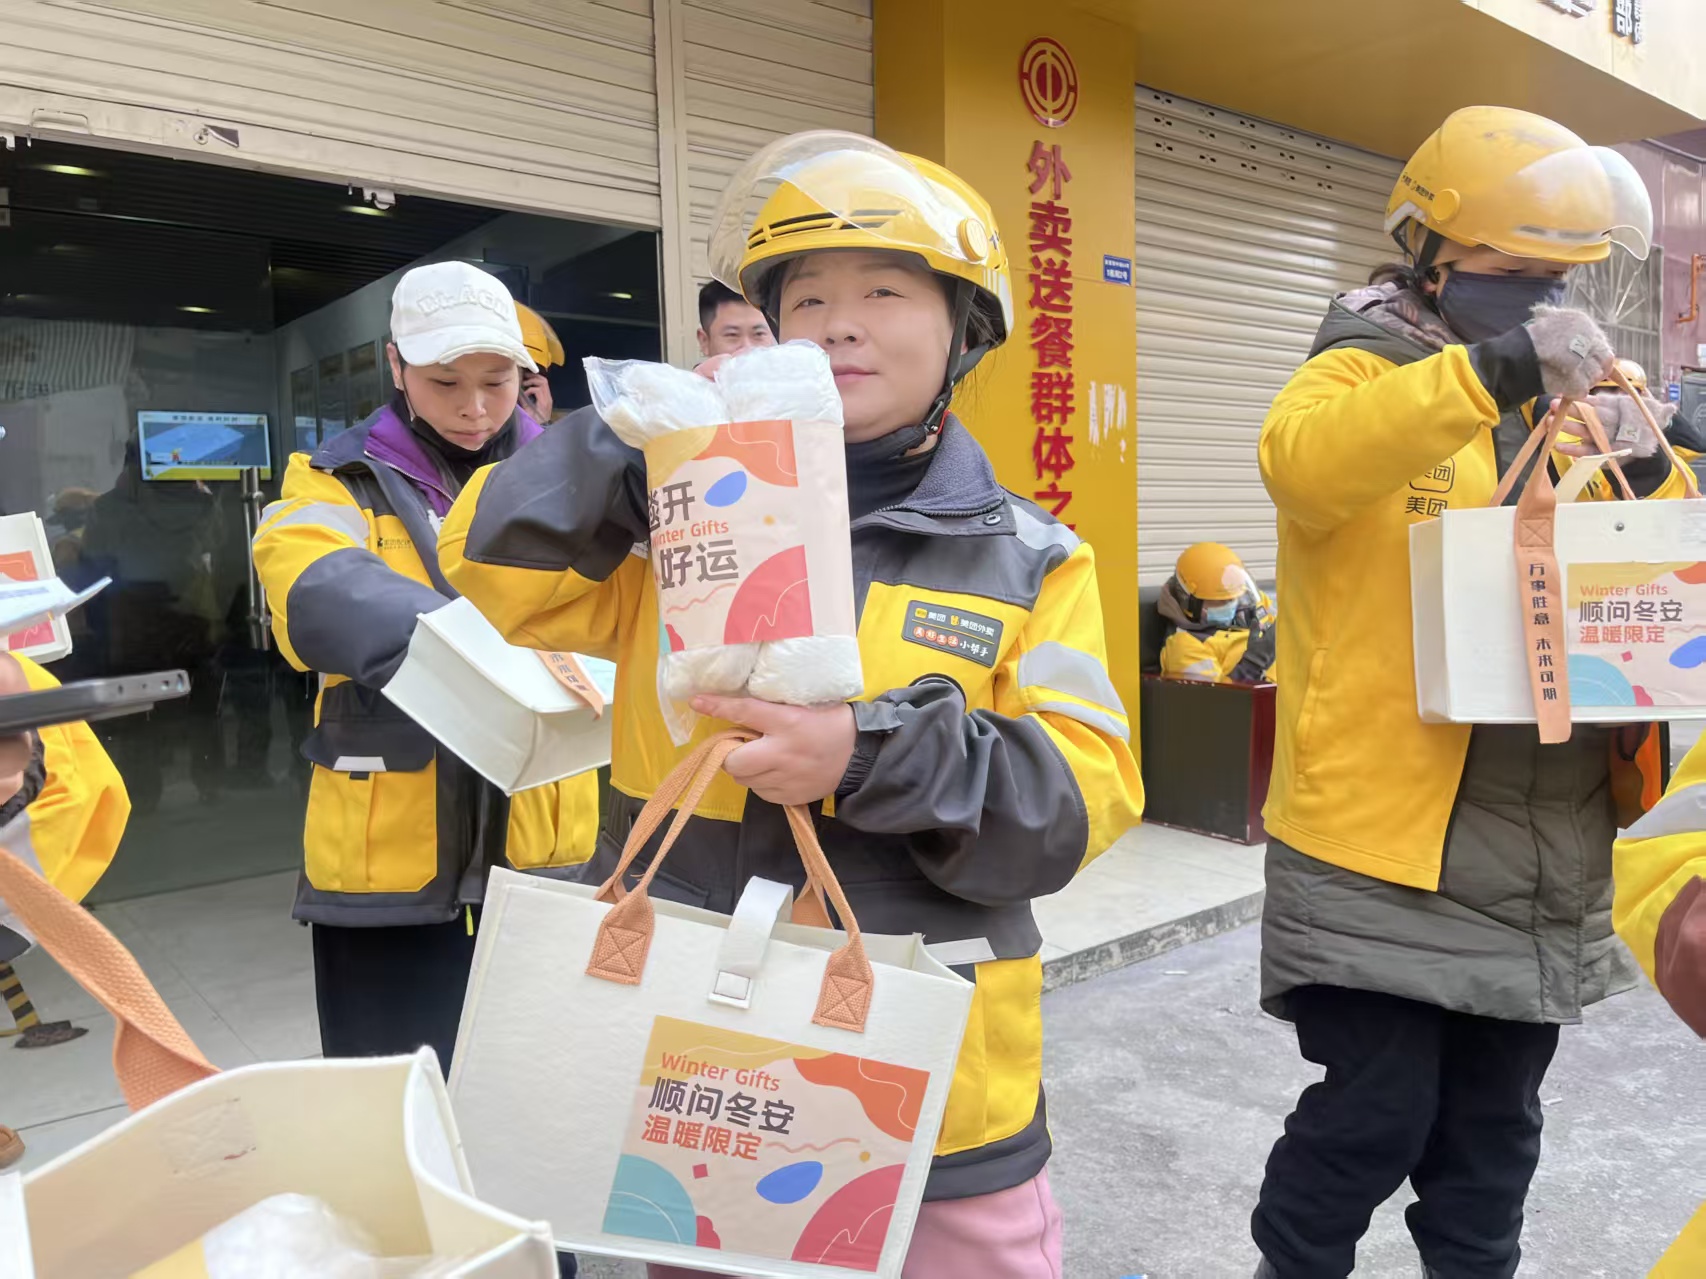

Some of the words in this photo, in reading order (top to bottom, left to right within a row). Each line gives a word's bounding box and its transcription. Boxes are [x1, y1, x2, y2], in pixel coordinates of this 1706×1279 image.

[1027, 139, 1076, 531] 外卖送餐群体之
[1405, 496, 1448, 517] 美团
[690, 519, 730, 537] Gifts
[660, 539, 740, 590] 好运
[1579, 584, 1630, 597] Winter
[1635, 583, 1669, 596] Gifts
[1578, 599, 1684, 623] 顺问冬安
[1579, 625, 1666, 644] 温暖限定
[661, 1052, 730, 1081] Winter
[735, 1067, 781, 1092] Gifts
[647, 1076, 796, 1135] 顺问冬安
[640, 1113, 763, 1161] 温暖限定
